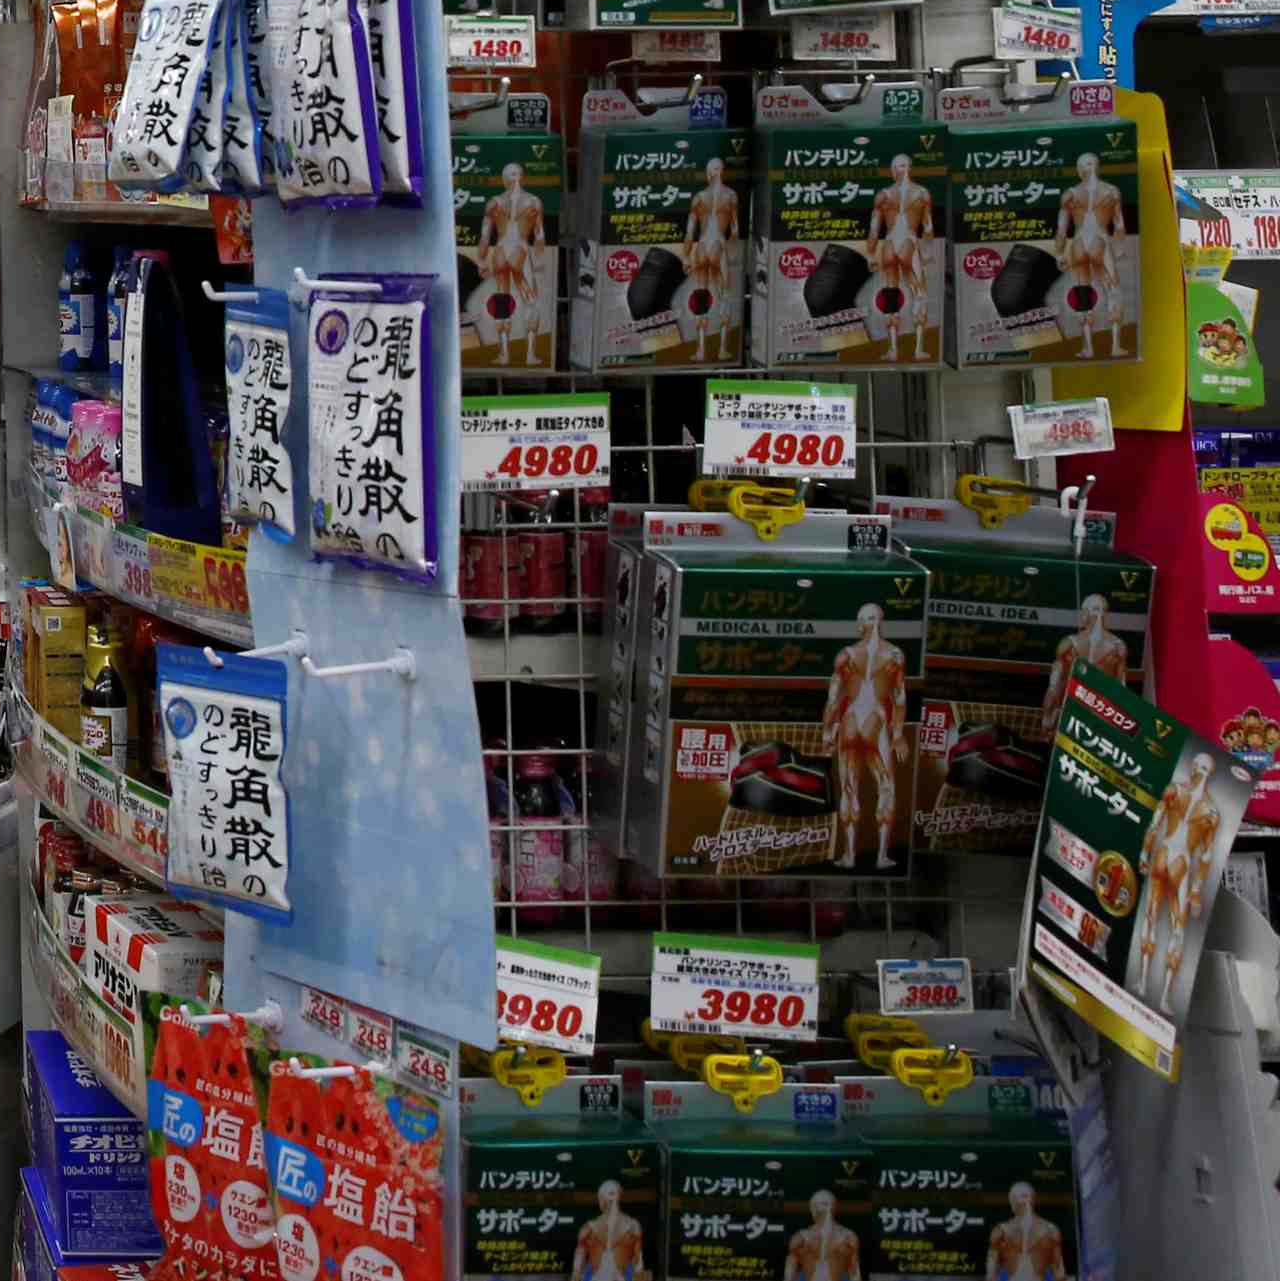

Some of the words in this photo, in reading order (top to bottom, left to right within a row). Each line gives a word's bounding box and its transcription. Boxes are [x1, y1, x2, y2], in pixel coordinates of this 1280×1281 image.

[615, 153, 686, 171] バンテリン
[784, 149, 866, 167] バンテリン
[965, 151, 1048, 168] バンテリン
[612, 187, 692, 208] サポーター
[782, 183, 876, 205] サポーター
[963, 184, 1061, 206] サポーター
[747, 432, 845, 465] 4980
[498, 444, 598, 478] 4980
[696, 622, 772, 636] MEDICAL
[775, 623, 816, 636] IDEA
[1067, 715, 1143, 776] バンテリン
[1058, 753, 1142, 824] サポーター
[700, 987, 806, 1028] 3980
[479, 1168, 561, 1191] バンテリン
[682, 1175, 773, 1196] バンテリン
[879, 1168, 969, 1190] バンテリン
[324, 1163, 418, 1242] 塩飴
[476, 1209, 575, 1235] サポーター
[680, 1214, 785, 1240] サポーター
[878, 1209, 984, 1234] サポーター
